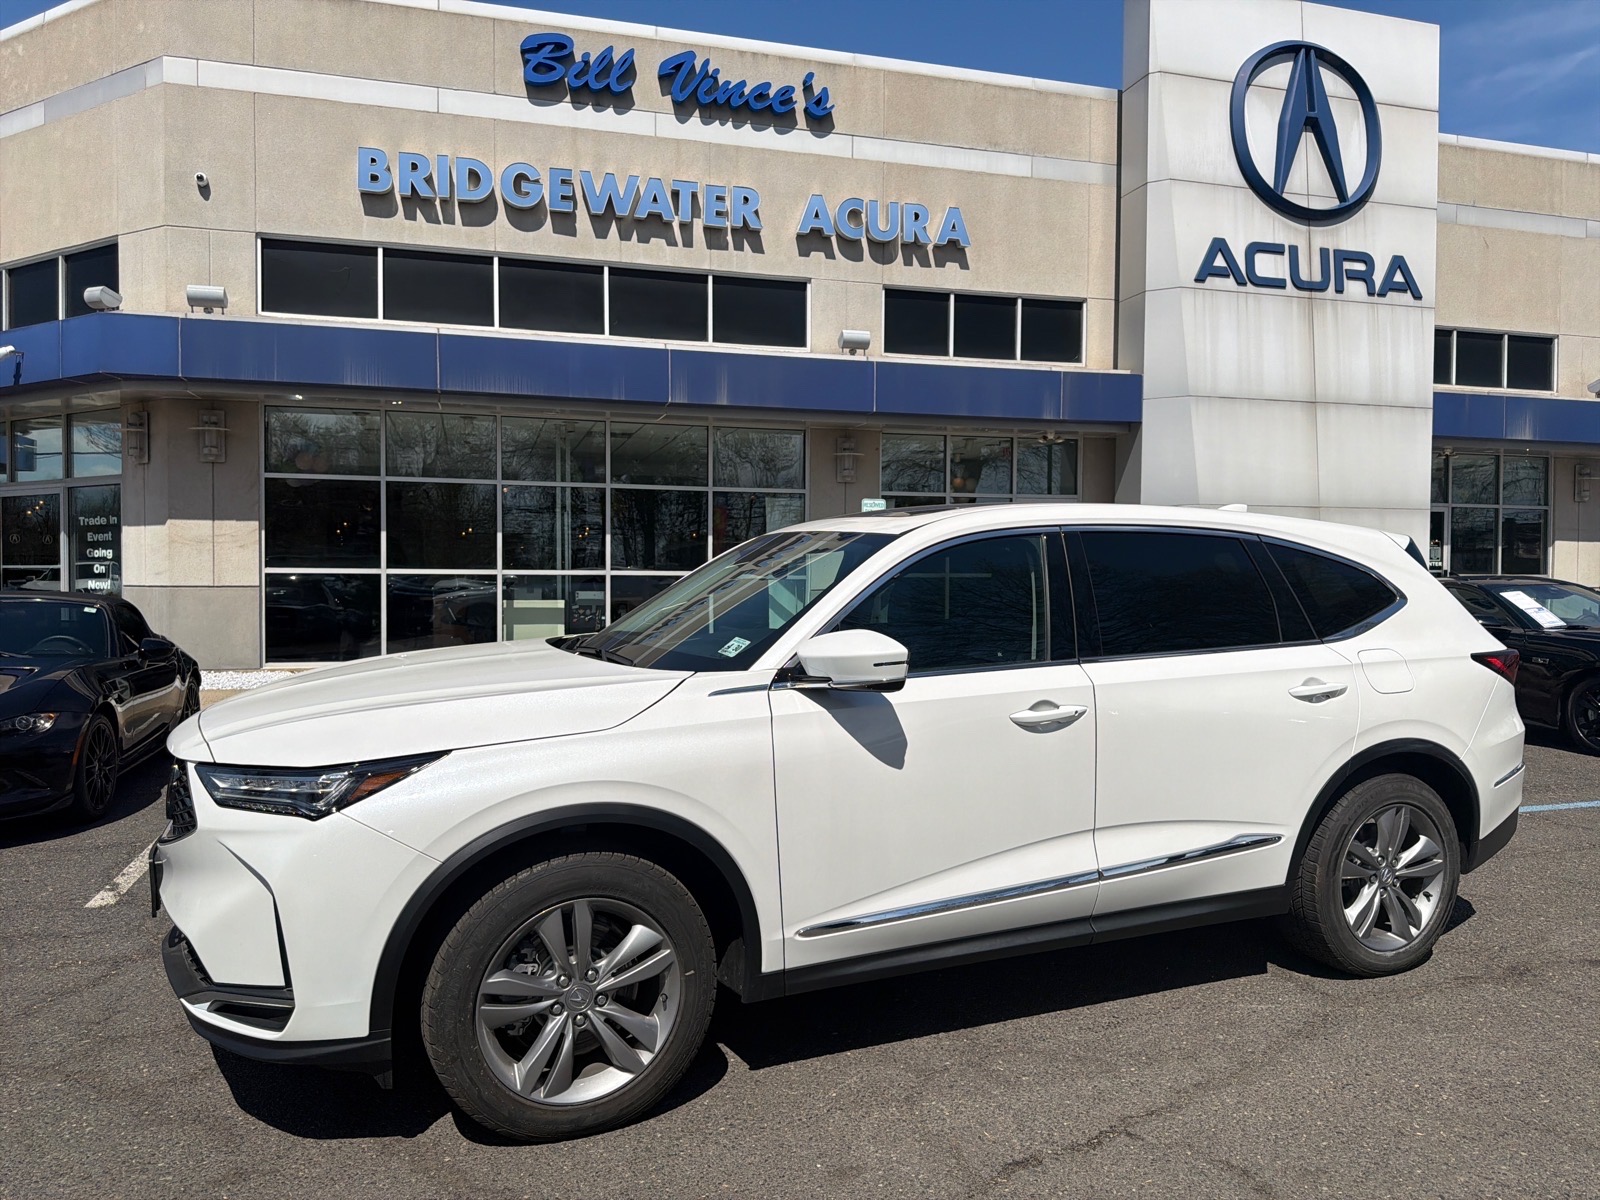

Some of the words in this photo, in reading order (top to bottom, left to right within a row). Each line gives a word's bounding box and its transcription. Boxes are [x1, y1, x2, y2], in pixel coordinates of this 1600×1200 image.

[520, 32, 635, 95] Bill
[658, 50, 835, 119] Vince's
[357, 146, 764, 232] BRIDGEWATER
[797, 193, 972, 249] ACURA
[1194, 237, 1423, 300] ACURA
[79, 516, 106, 526] Trade
[87, 531, 112, 541] Event
[86, 548, 112, 558] Going
[93, 564, 105, 573] On
[88, 580, 110, 589] Now!
